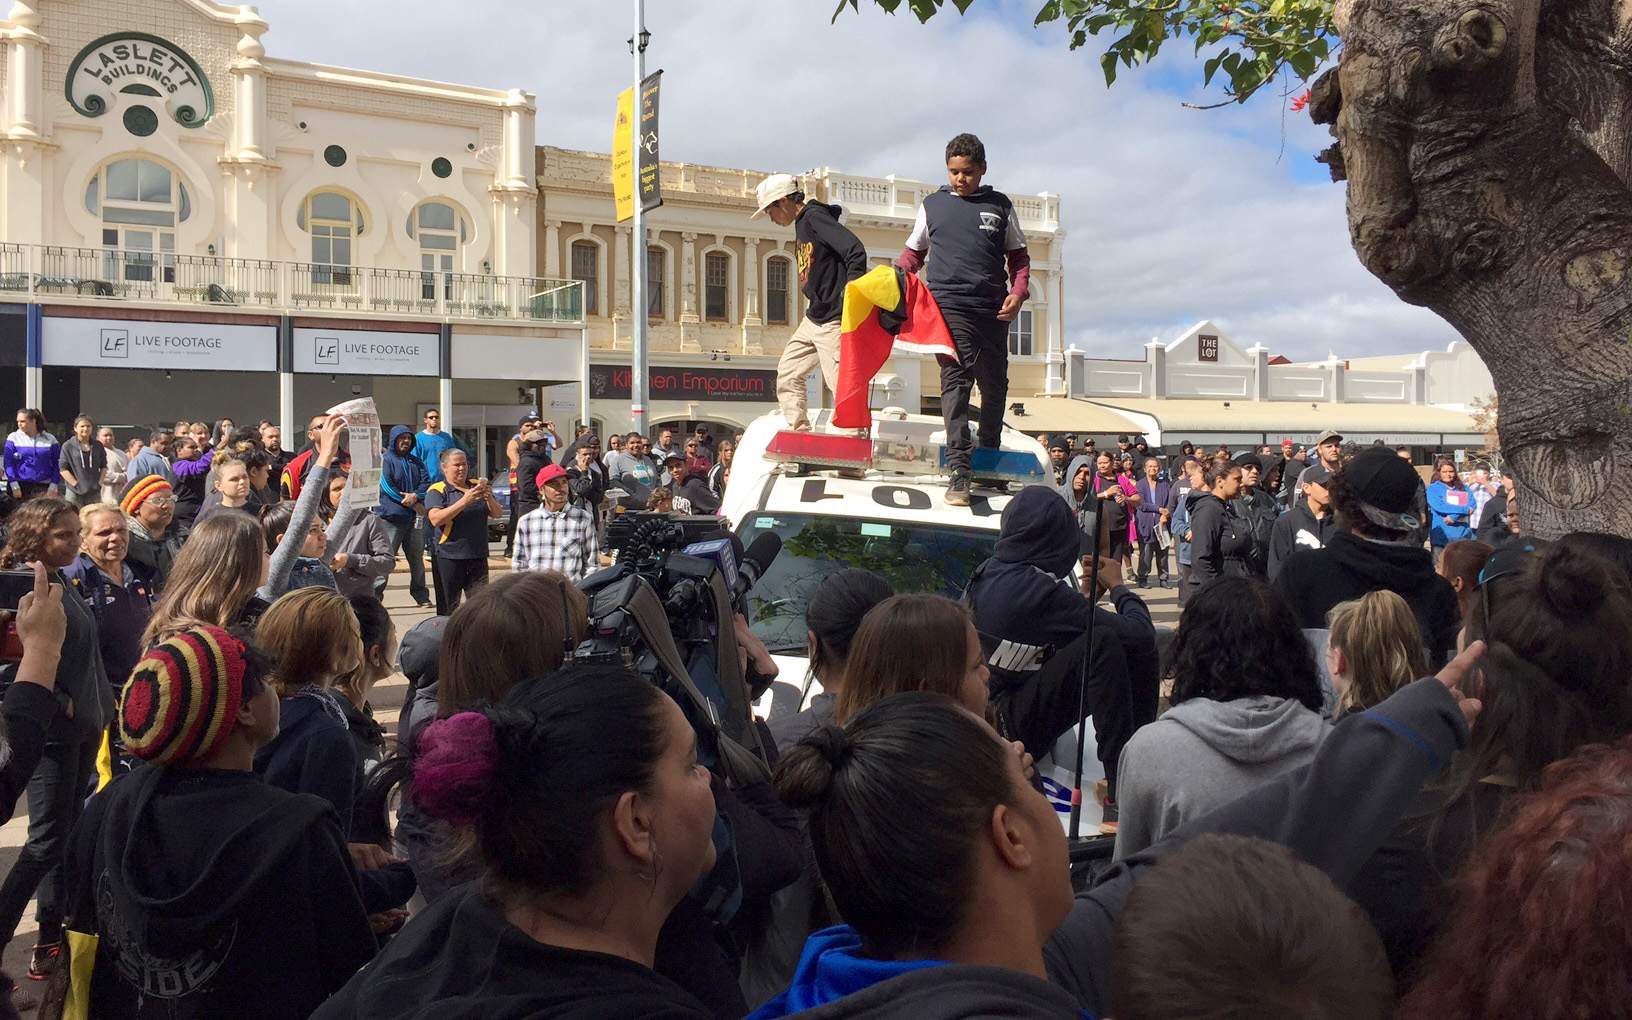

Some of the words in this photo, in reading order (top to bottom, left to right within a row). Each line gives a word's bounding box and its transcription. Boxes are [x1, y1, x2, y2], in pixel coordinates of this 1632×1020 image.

[83, 43, 197, 87] LASLETT
[101, 63, 178, 93] BUILDINGS
[135, 336, 160, 346] LIVE
[164, 336, 222, 349] FOOTAGE
[1201, 339, 1217, 348] THE
[345, 344, 367, 354] LIVE
[370, 344, 420, 356] FOOTAGE
[1201, 347, 1217, 358] LOT
[613, 368, 676, 389] Kiten
[683, 372, 764, 395] Emporium
